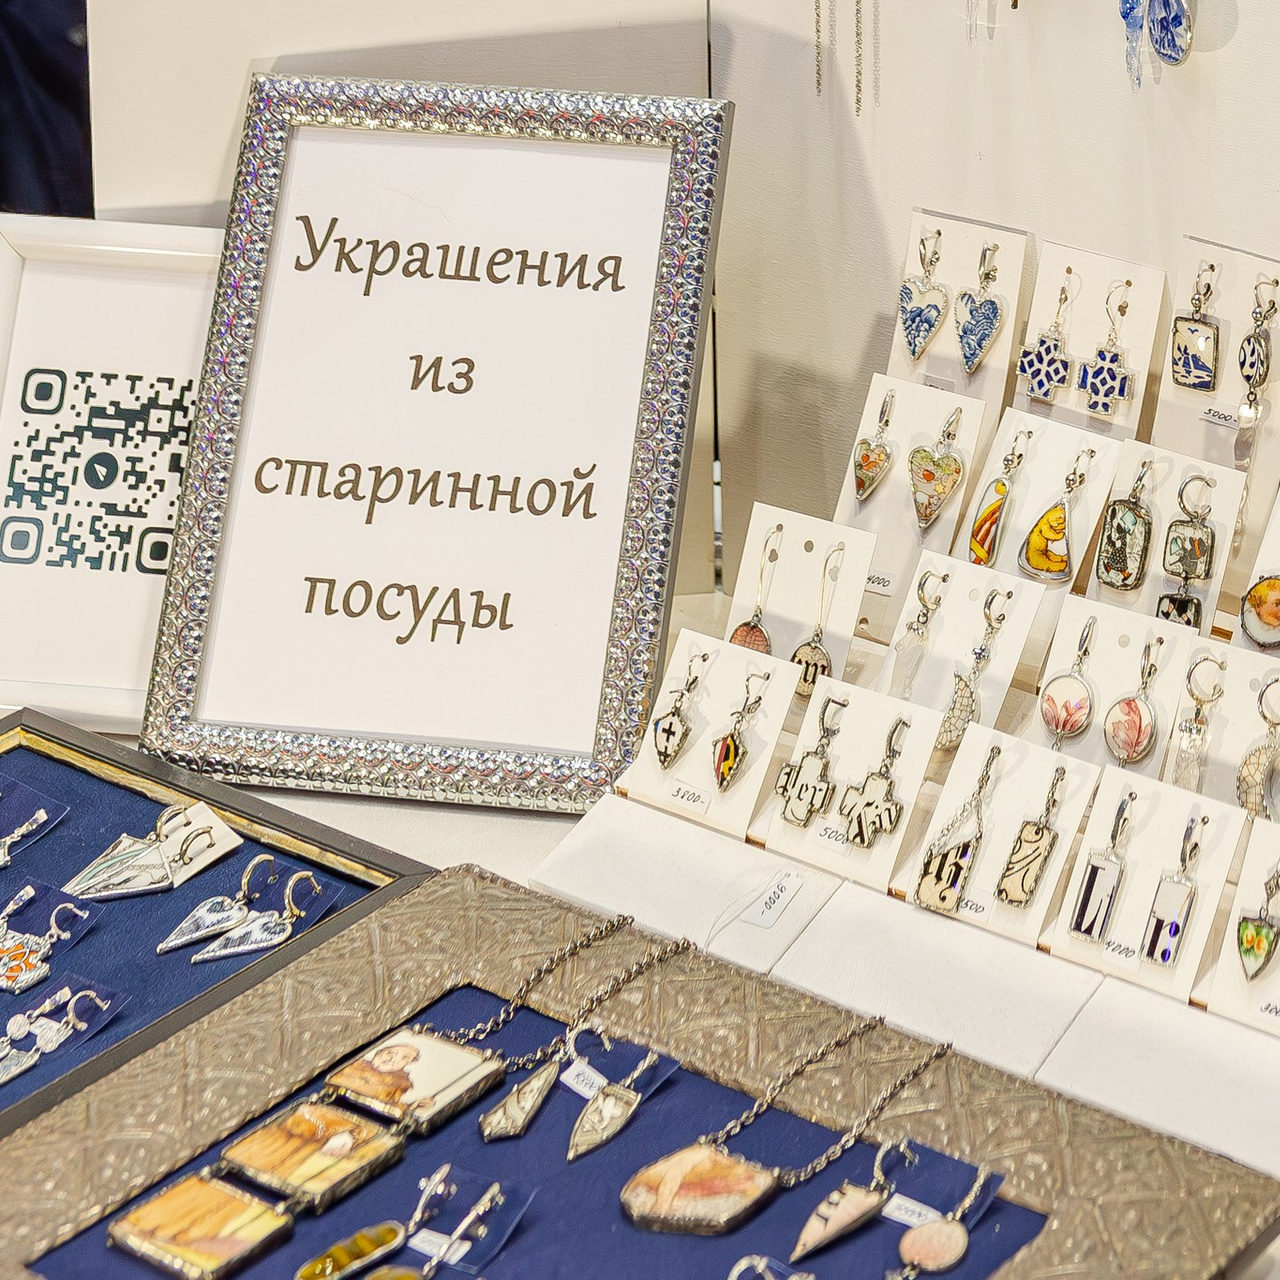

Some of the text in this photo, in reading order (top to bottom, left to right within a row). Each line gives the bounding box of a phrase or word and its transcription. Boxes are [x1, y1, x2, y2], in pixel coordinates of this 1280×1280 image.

[294, 215, 627, 297] Украшения
[408, 353, 476, 395] из
[254, 456, 598, 525] старинной
[304, 576, 514, 645] посуды
